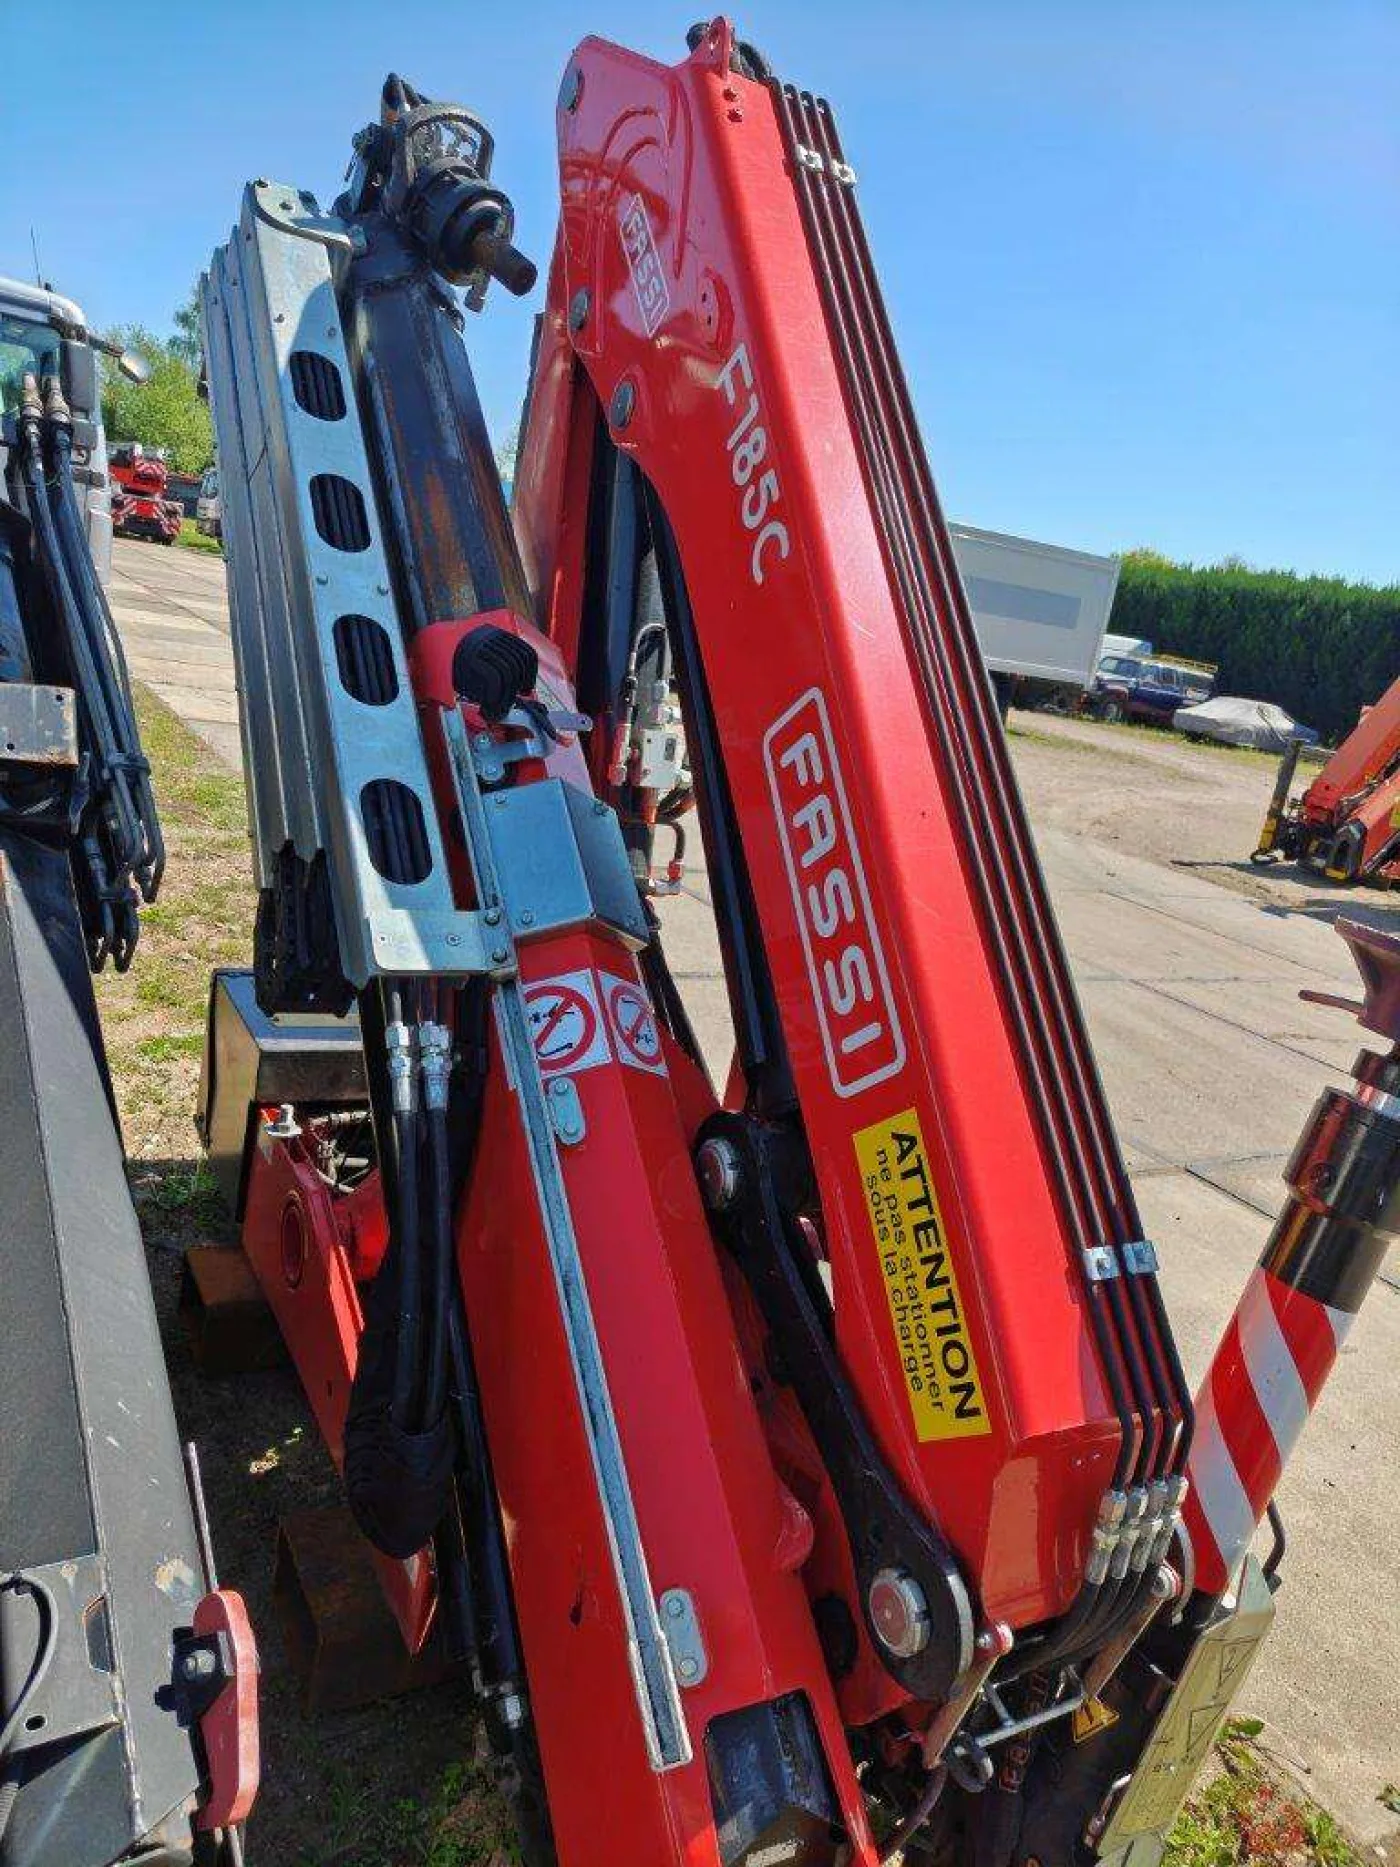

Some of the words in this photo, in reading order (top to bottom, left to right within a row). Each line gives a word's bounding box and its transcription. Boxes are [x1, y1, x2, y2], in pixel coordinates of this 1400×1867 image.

[624, 210, 664, 321] FASSI
[714, 343, 790, 585] F185C
[781, 732, 882, 1053] FASSI
[866, 1175, 889, 1242] sous
[884, 1250, 898, 1277] la
[892, 1288, 923, 1392] charge
[877, 1149, 890, 1181] ne
[884, 1194, 906, 1244] pas
[901, 1257, 944, 1412] stationner
[891, 1131, 981, 1419] ATTENTION
